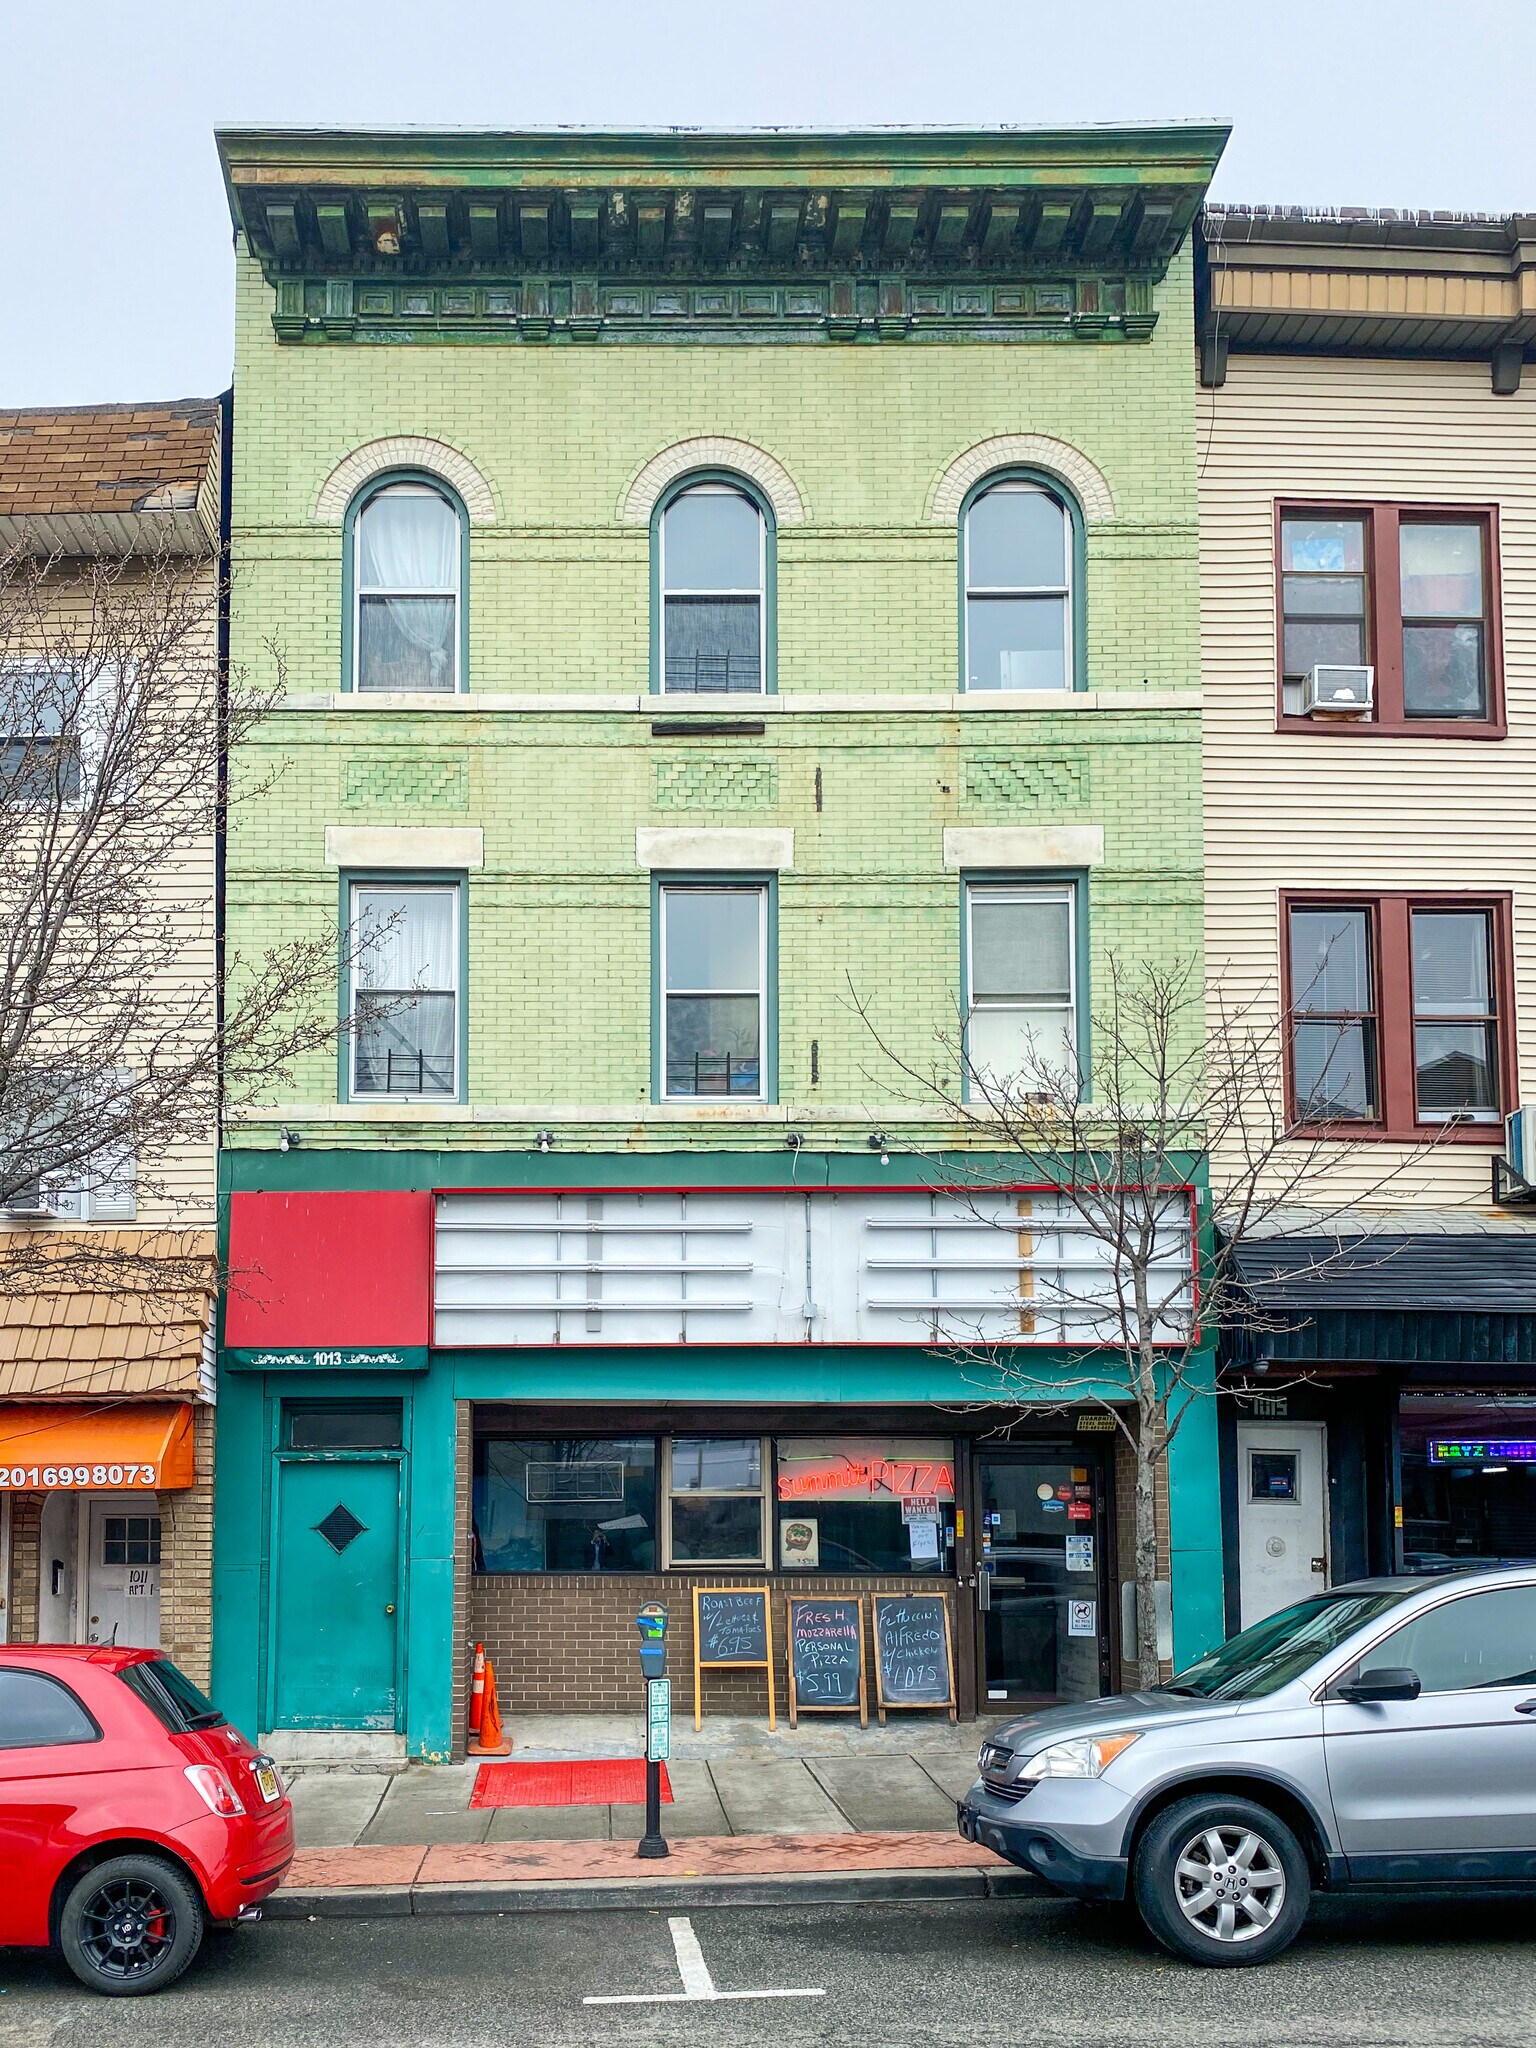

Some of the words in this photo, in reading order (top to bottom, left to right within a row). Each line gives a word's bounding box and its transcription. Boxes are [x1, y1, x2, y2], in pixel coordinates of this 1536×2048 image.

[313, 1351, 342, 1366] 1013
[0, 1465, 156, 1487] 2016998073
[871, 1460, 954, 1494] PIZZA
[910, 1497, 930, 1506] HELP
[905, 1505, 936, 1514] WANTED
[130, 1570, 148, 1583] 1011
[703, 1596, 733, 1611] ROAST
[735, 1596, 763, 1607] BEEF
[796, 1604, 845, 1627] FRESH
[796, 1638, 853, 1653] PERSONAL
[796, 1669, 842, 1693] $5.99
